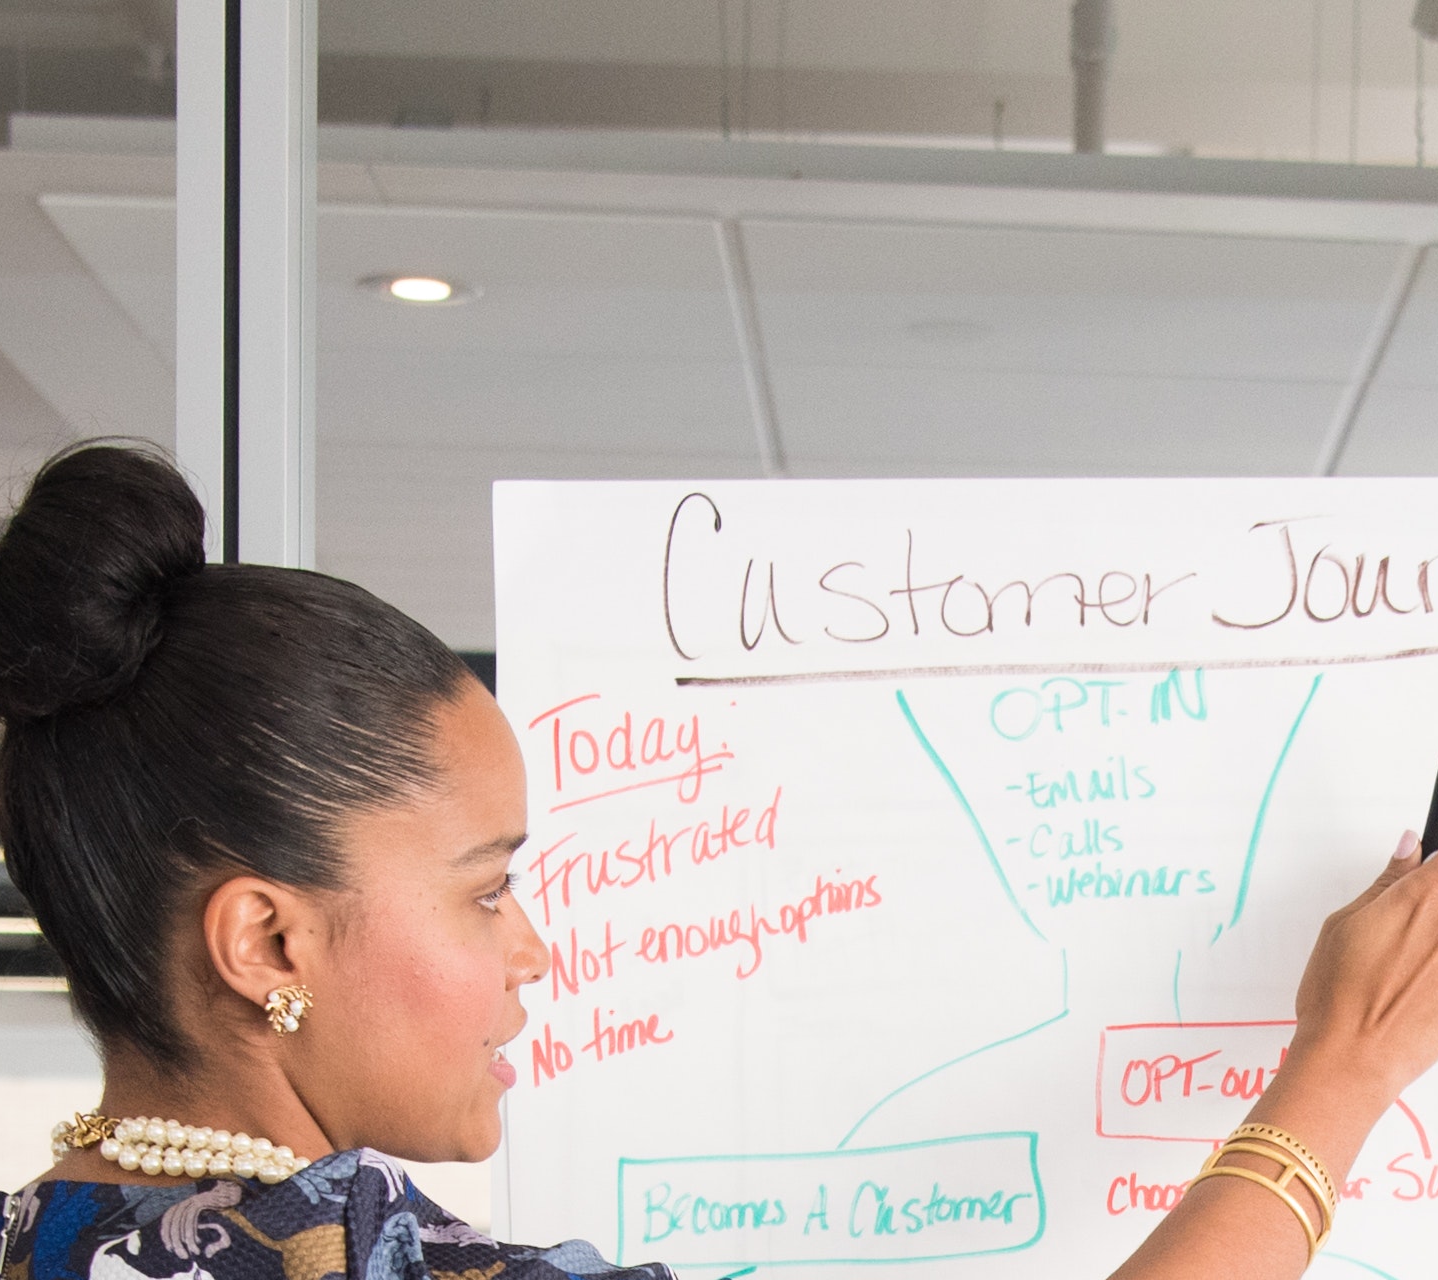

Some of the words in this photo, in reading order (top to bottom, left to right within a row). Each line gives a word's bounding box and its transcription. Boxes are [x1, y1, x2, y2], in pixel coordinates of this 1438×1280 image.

[663, 493, 1197, 661] Customer
[527, 786, 783, 927] Frustrated
[551, 927, 627, 1001] Not
[635, 903, 780, 981] enough
[779, 868, 882, 944] options
[531, 1023, 575, 1088] No
[582, 1007, 675, 1062] time
[642, 1182, 788, 1244] Becomes
[803, 1184, 828, 1238] A
[848, 1180, 1034, 1240] Customer
[1107, 1172, 1189, 1217] Choo
